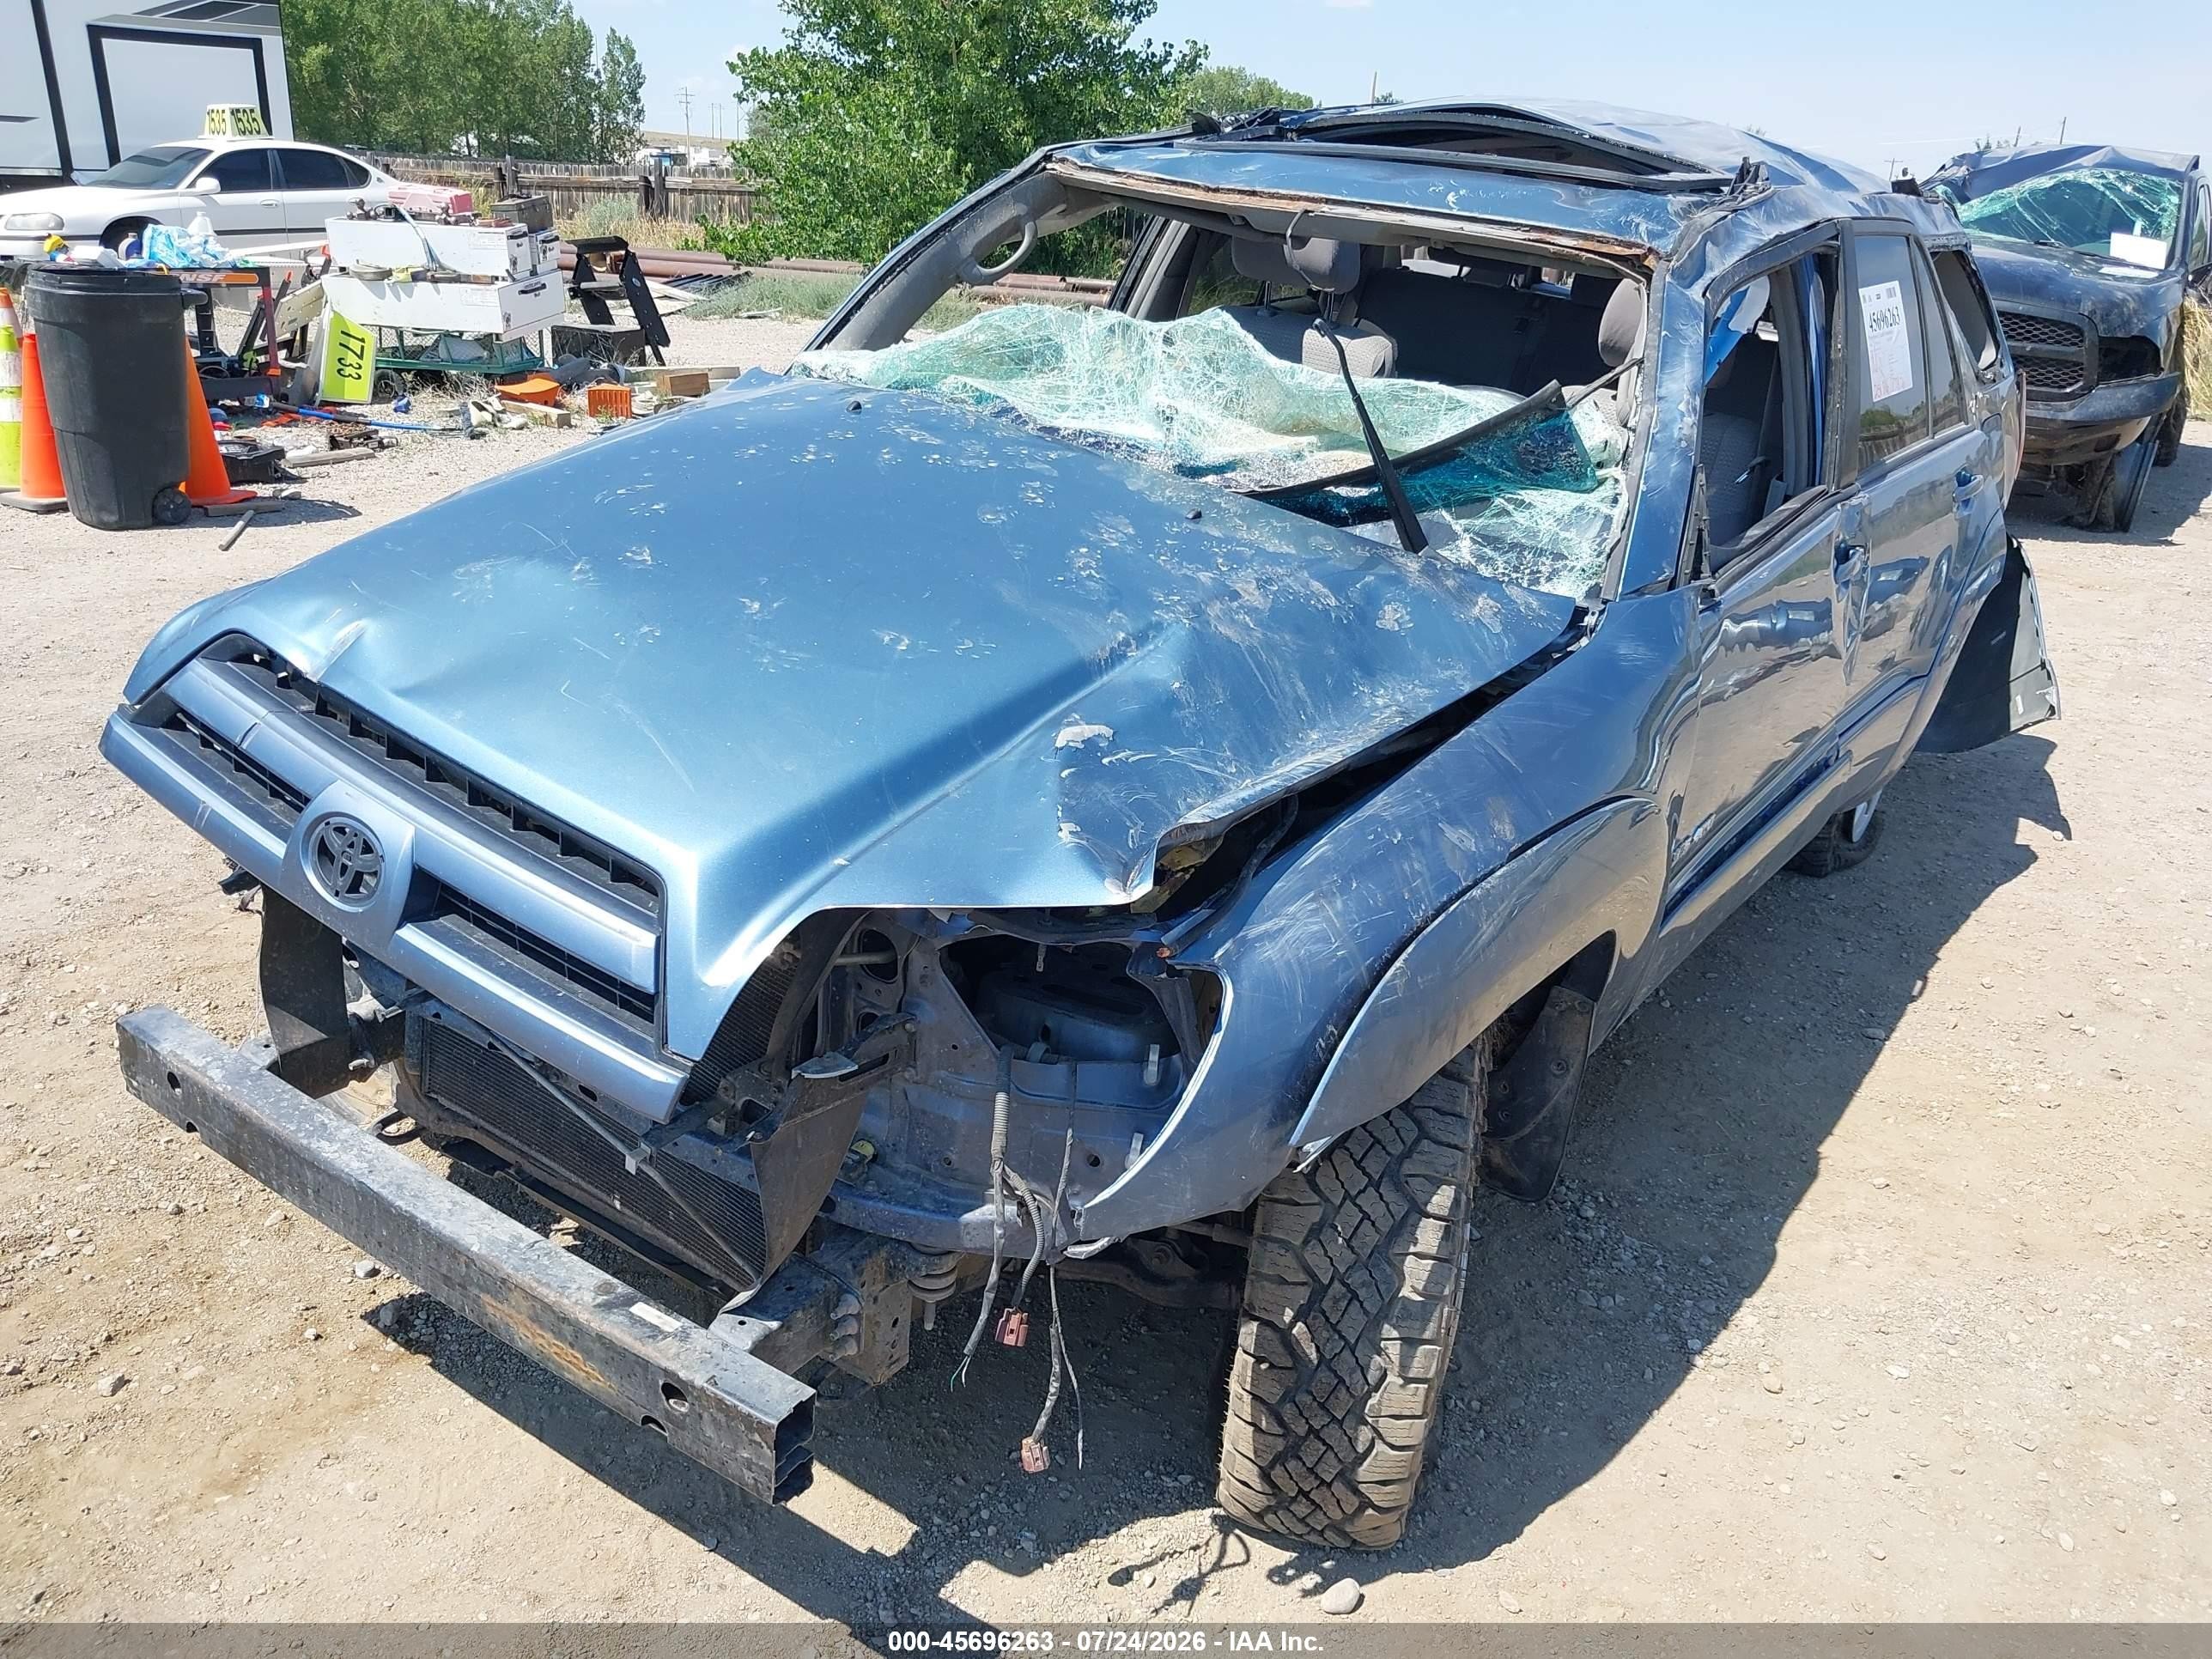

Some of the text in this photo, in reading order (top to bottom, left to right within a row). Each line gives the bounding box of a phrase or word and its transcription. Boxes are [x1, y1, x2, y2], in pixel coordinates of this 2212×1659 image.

[206, 108, 227, 136] 1535
[230, 108, 261, 136] 1535
[173, 273, 227, 283] NSF
[1869, 306, 1901, 332] 45696263
[336, 330, 366, 380] 1733
